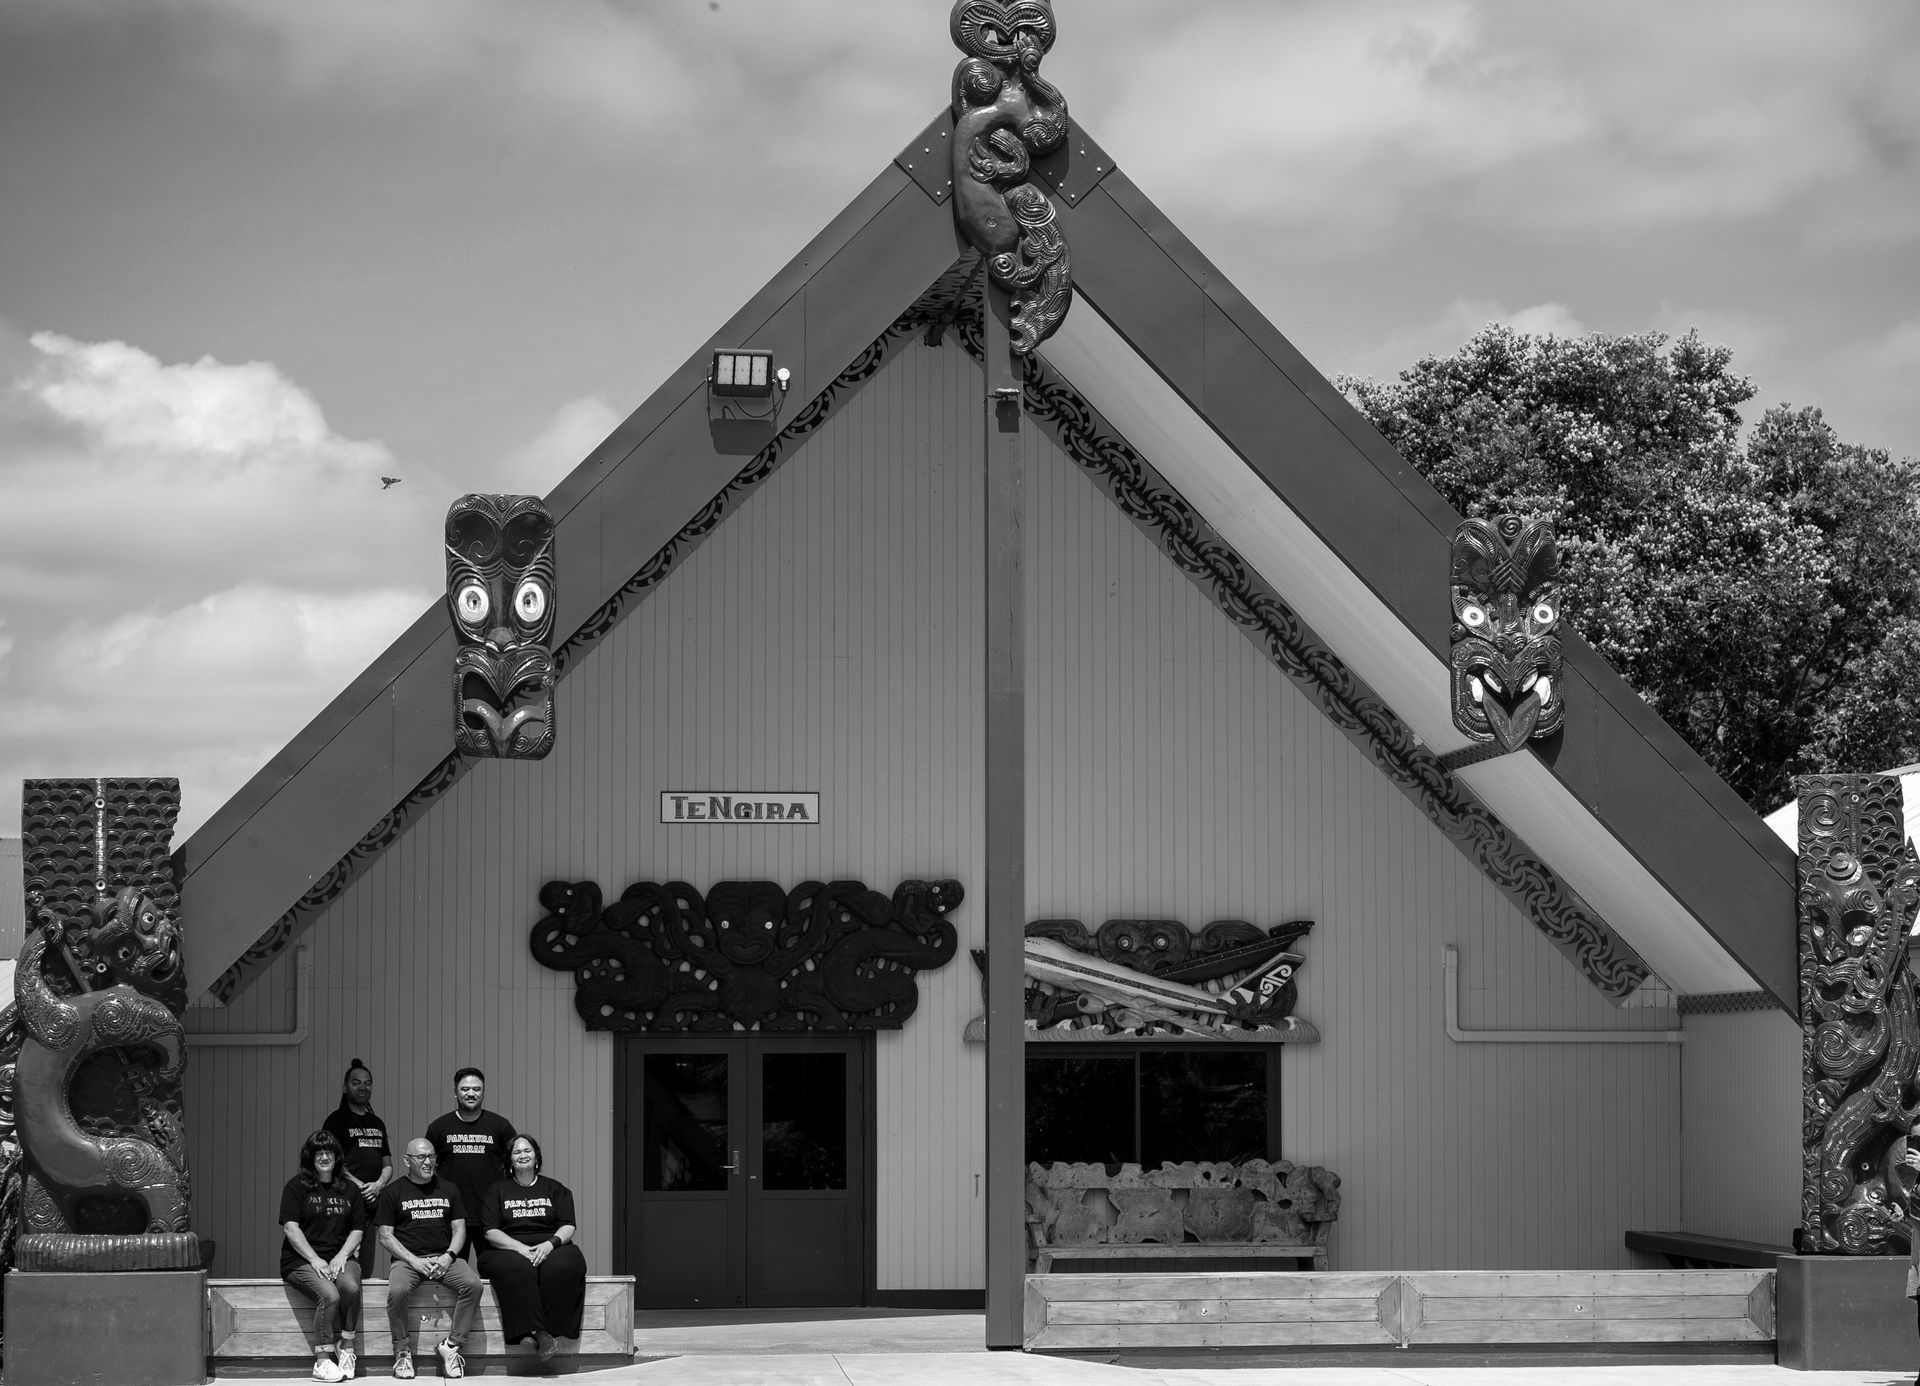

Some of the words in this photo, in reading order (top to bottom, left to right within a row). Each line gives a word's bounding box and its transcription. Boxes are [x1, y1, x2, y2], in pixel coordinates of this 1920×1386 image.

[447, 1134, 494, 1144] PAPAKURA
[453, 1145, 485, 1153] MARAE
[402, 1198, 450, 1210] PAPAKURA
[504, 1198, 552, 1209] PAPAKURA
[411, 1209, 443, 1219] MARAE
[513, 1208, 546, 1218] MARAE
